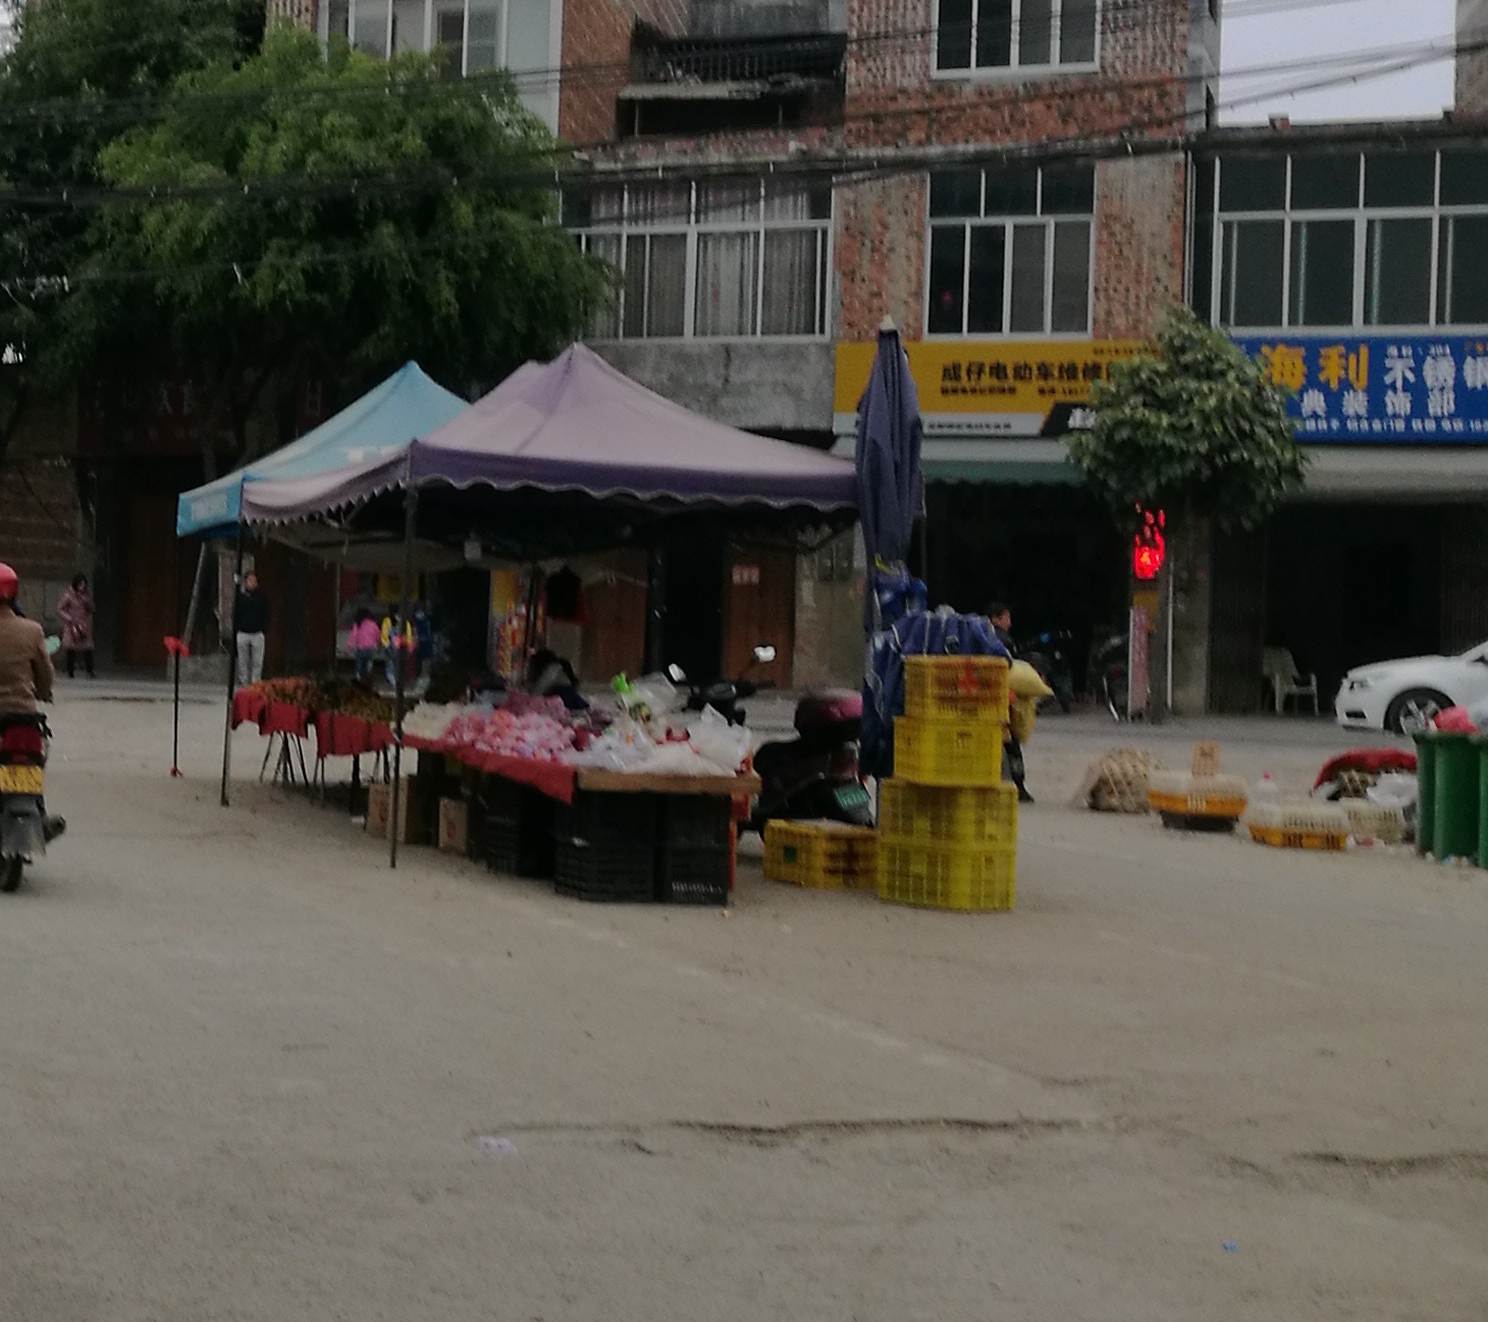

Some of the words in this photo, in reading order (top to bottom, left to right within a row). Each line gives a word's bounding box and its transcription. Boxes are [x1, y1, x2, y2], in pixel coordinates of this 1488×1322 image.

[941, 360, 1113, 383] 成仔电动车维修
